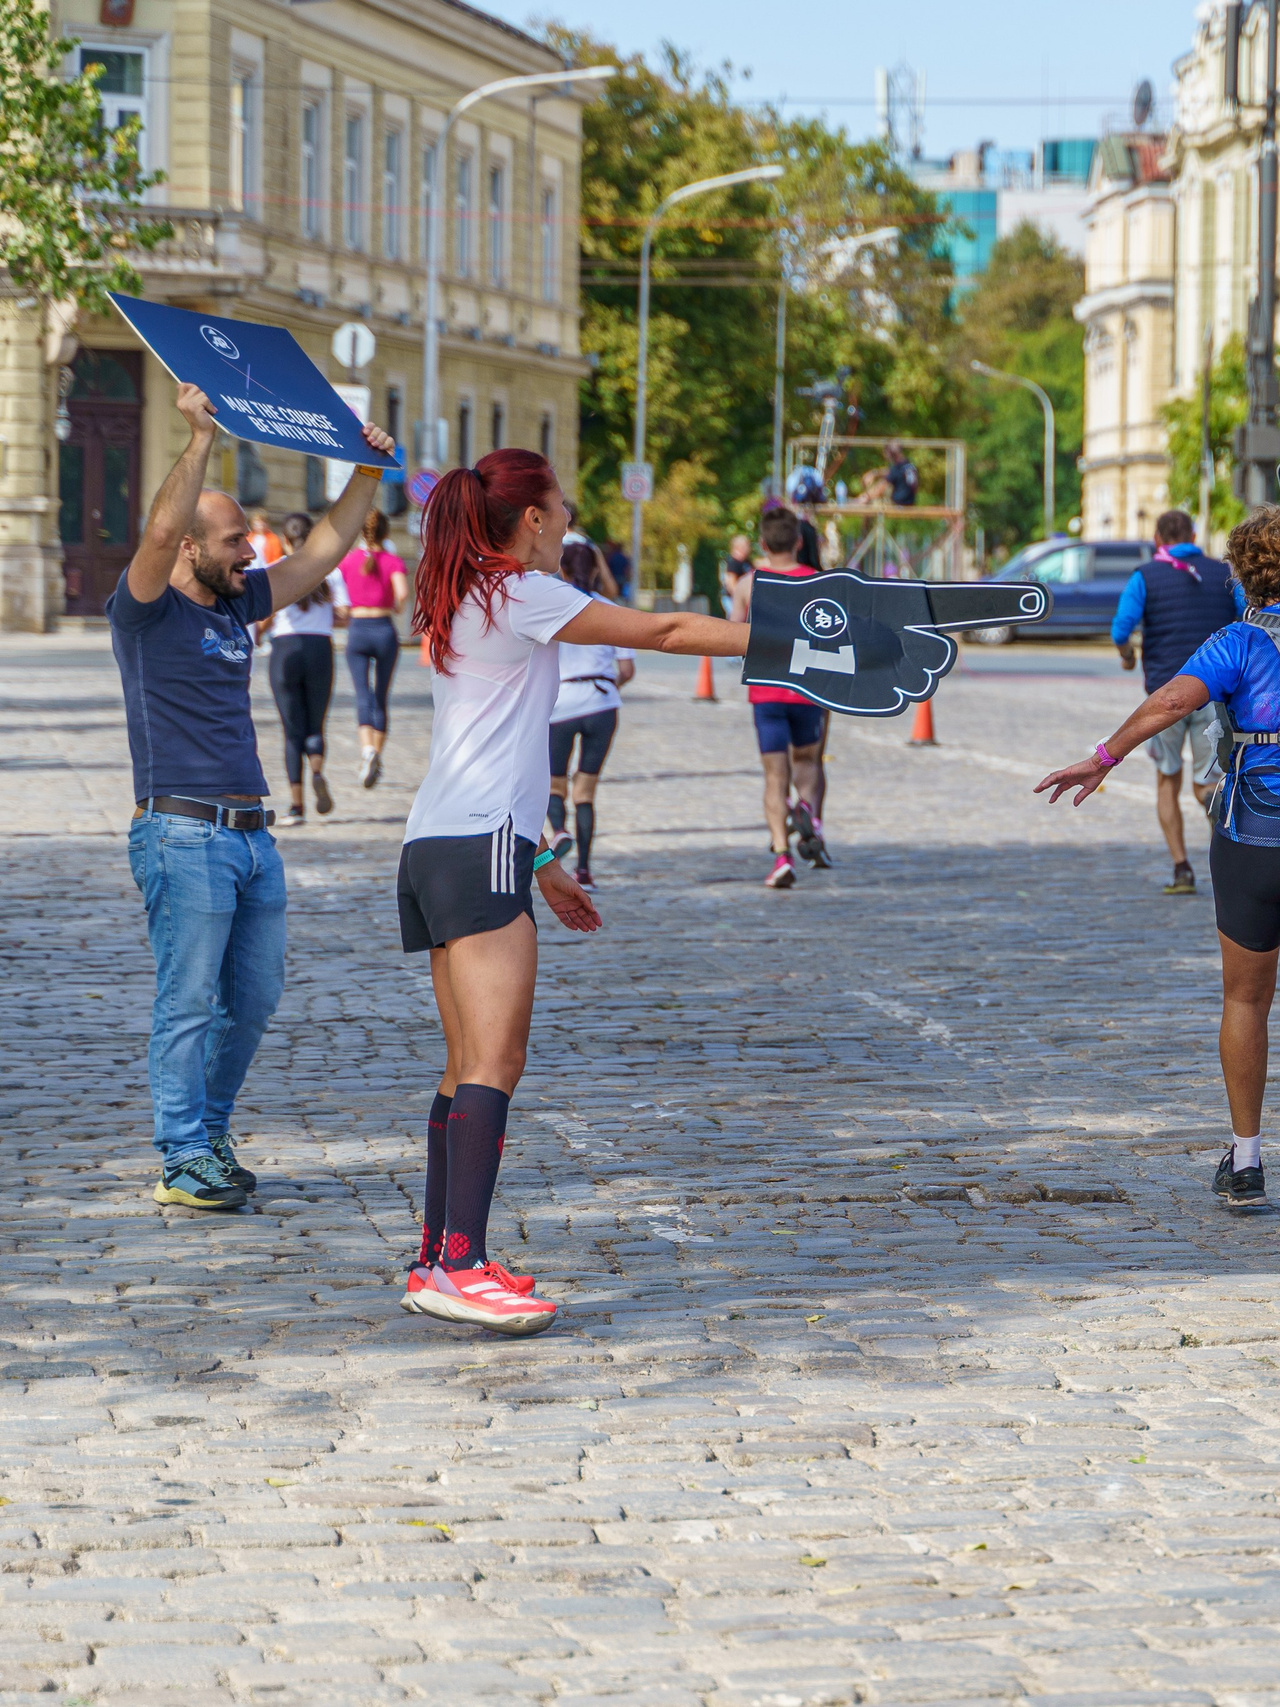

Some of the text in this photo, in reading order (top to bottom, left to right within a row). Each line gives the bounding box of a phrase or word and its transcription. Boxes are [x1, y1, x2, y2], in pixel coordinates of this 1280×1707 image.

[220, 393, 339, 432] MAY THE COURSE
[247, 415, 344, 449] BE WITH YOU.
